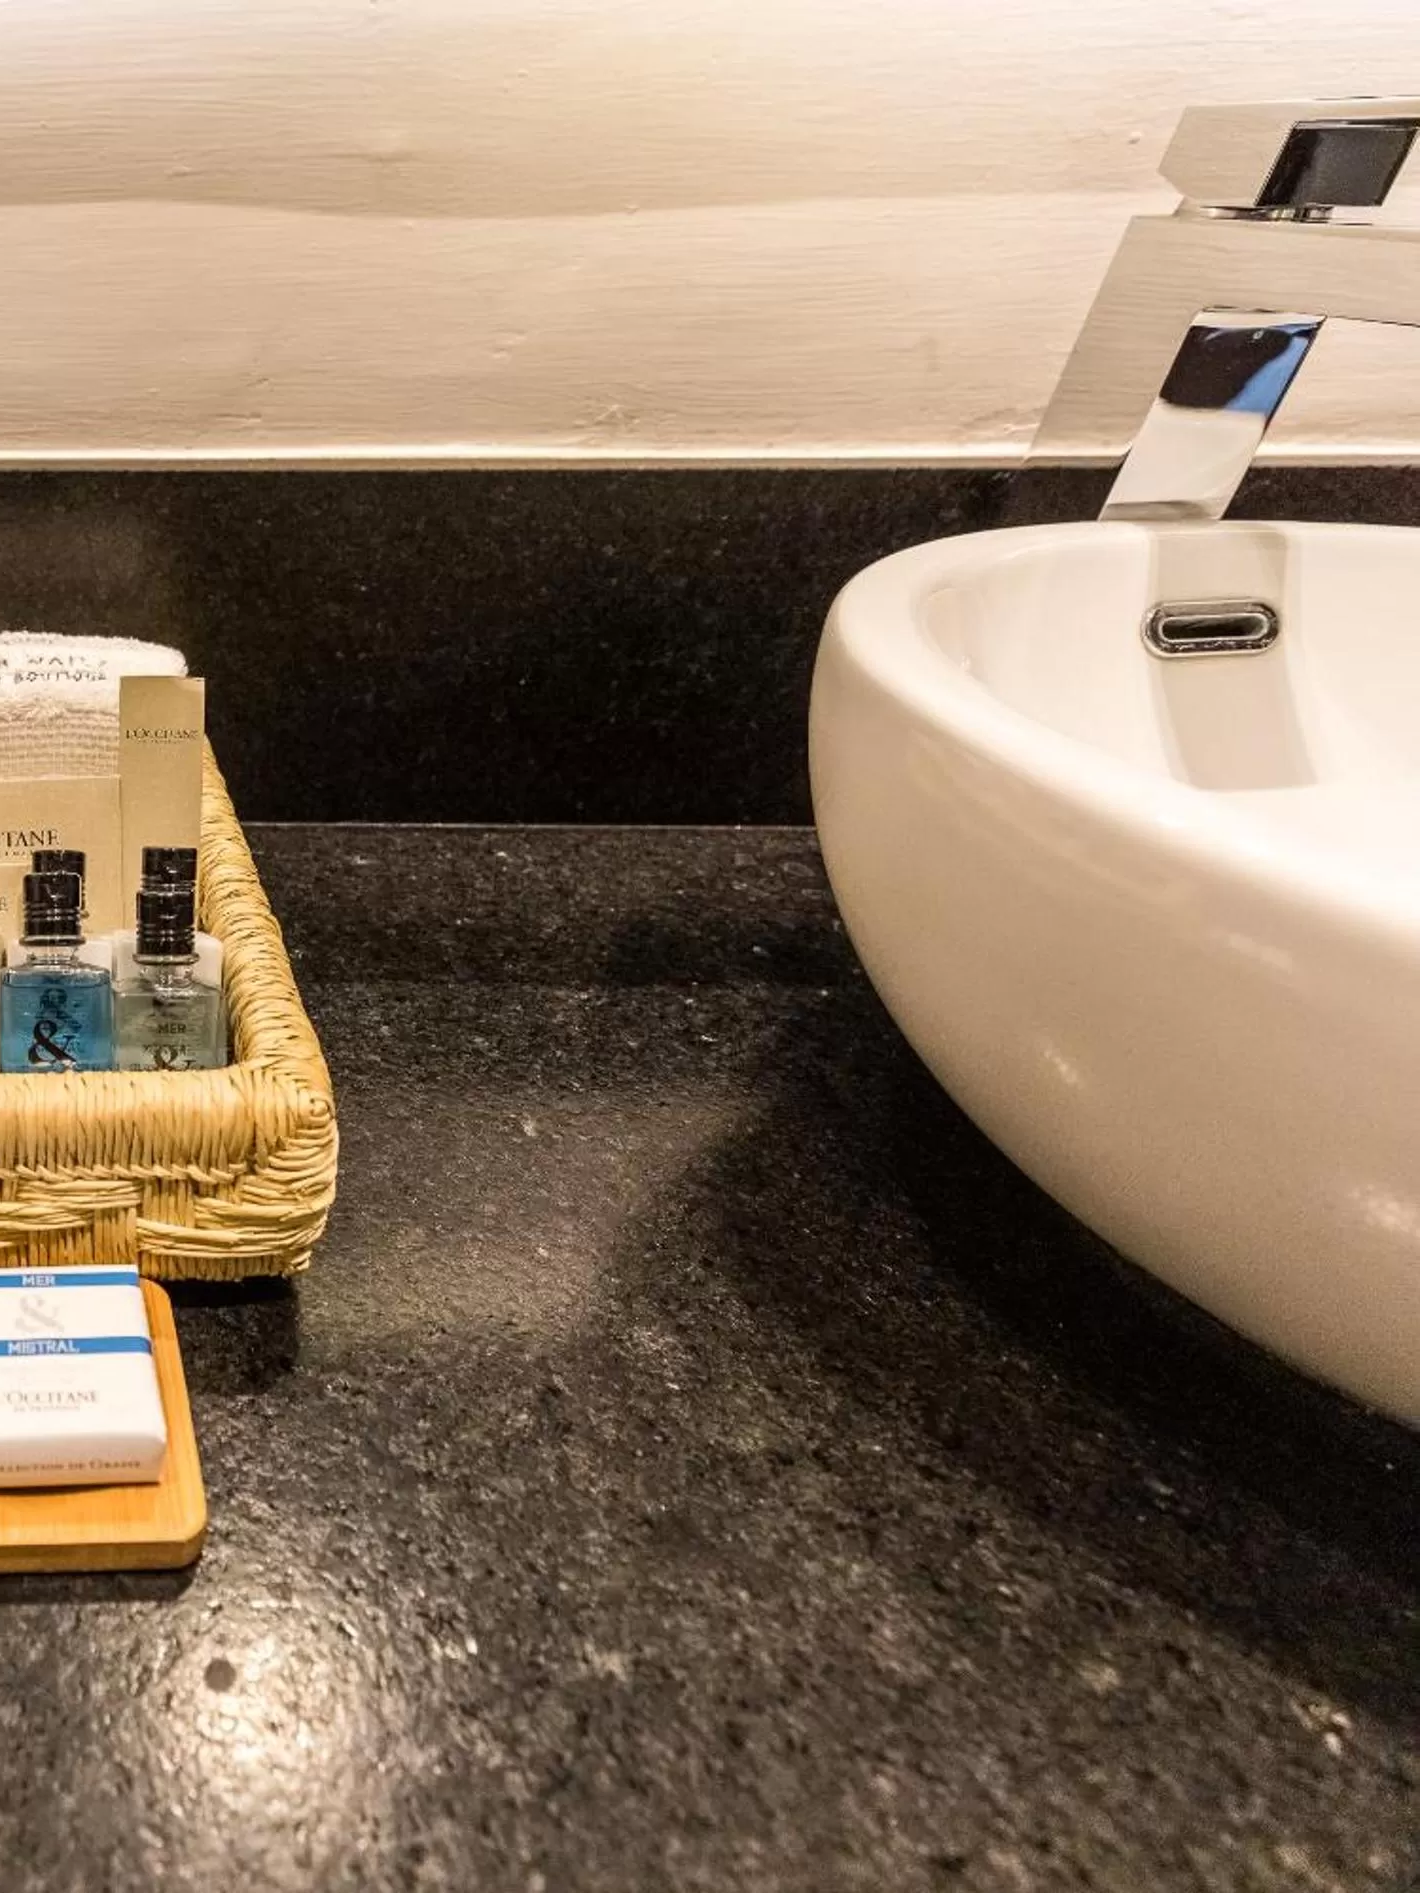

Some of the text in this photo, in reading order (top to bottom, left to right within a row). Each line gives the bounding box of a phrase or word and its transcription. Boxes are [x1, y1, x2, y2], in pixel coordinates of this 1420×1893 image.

[157, 1023, 187, 1034] MER
[22, 1275, 56, 1287] MER
[7, 1340, 80, 1355] MISTRAL
